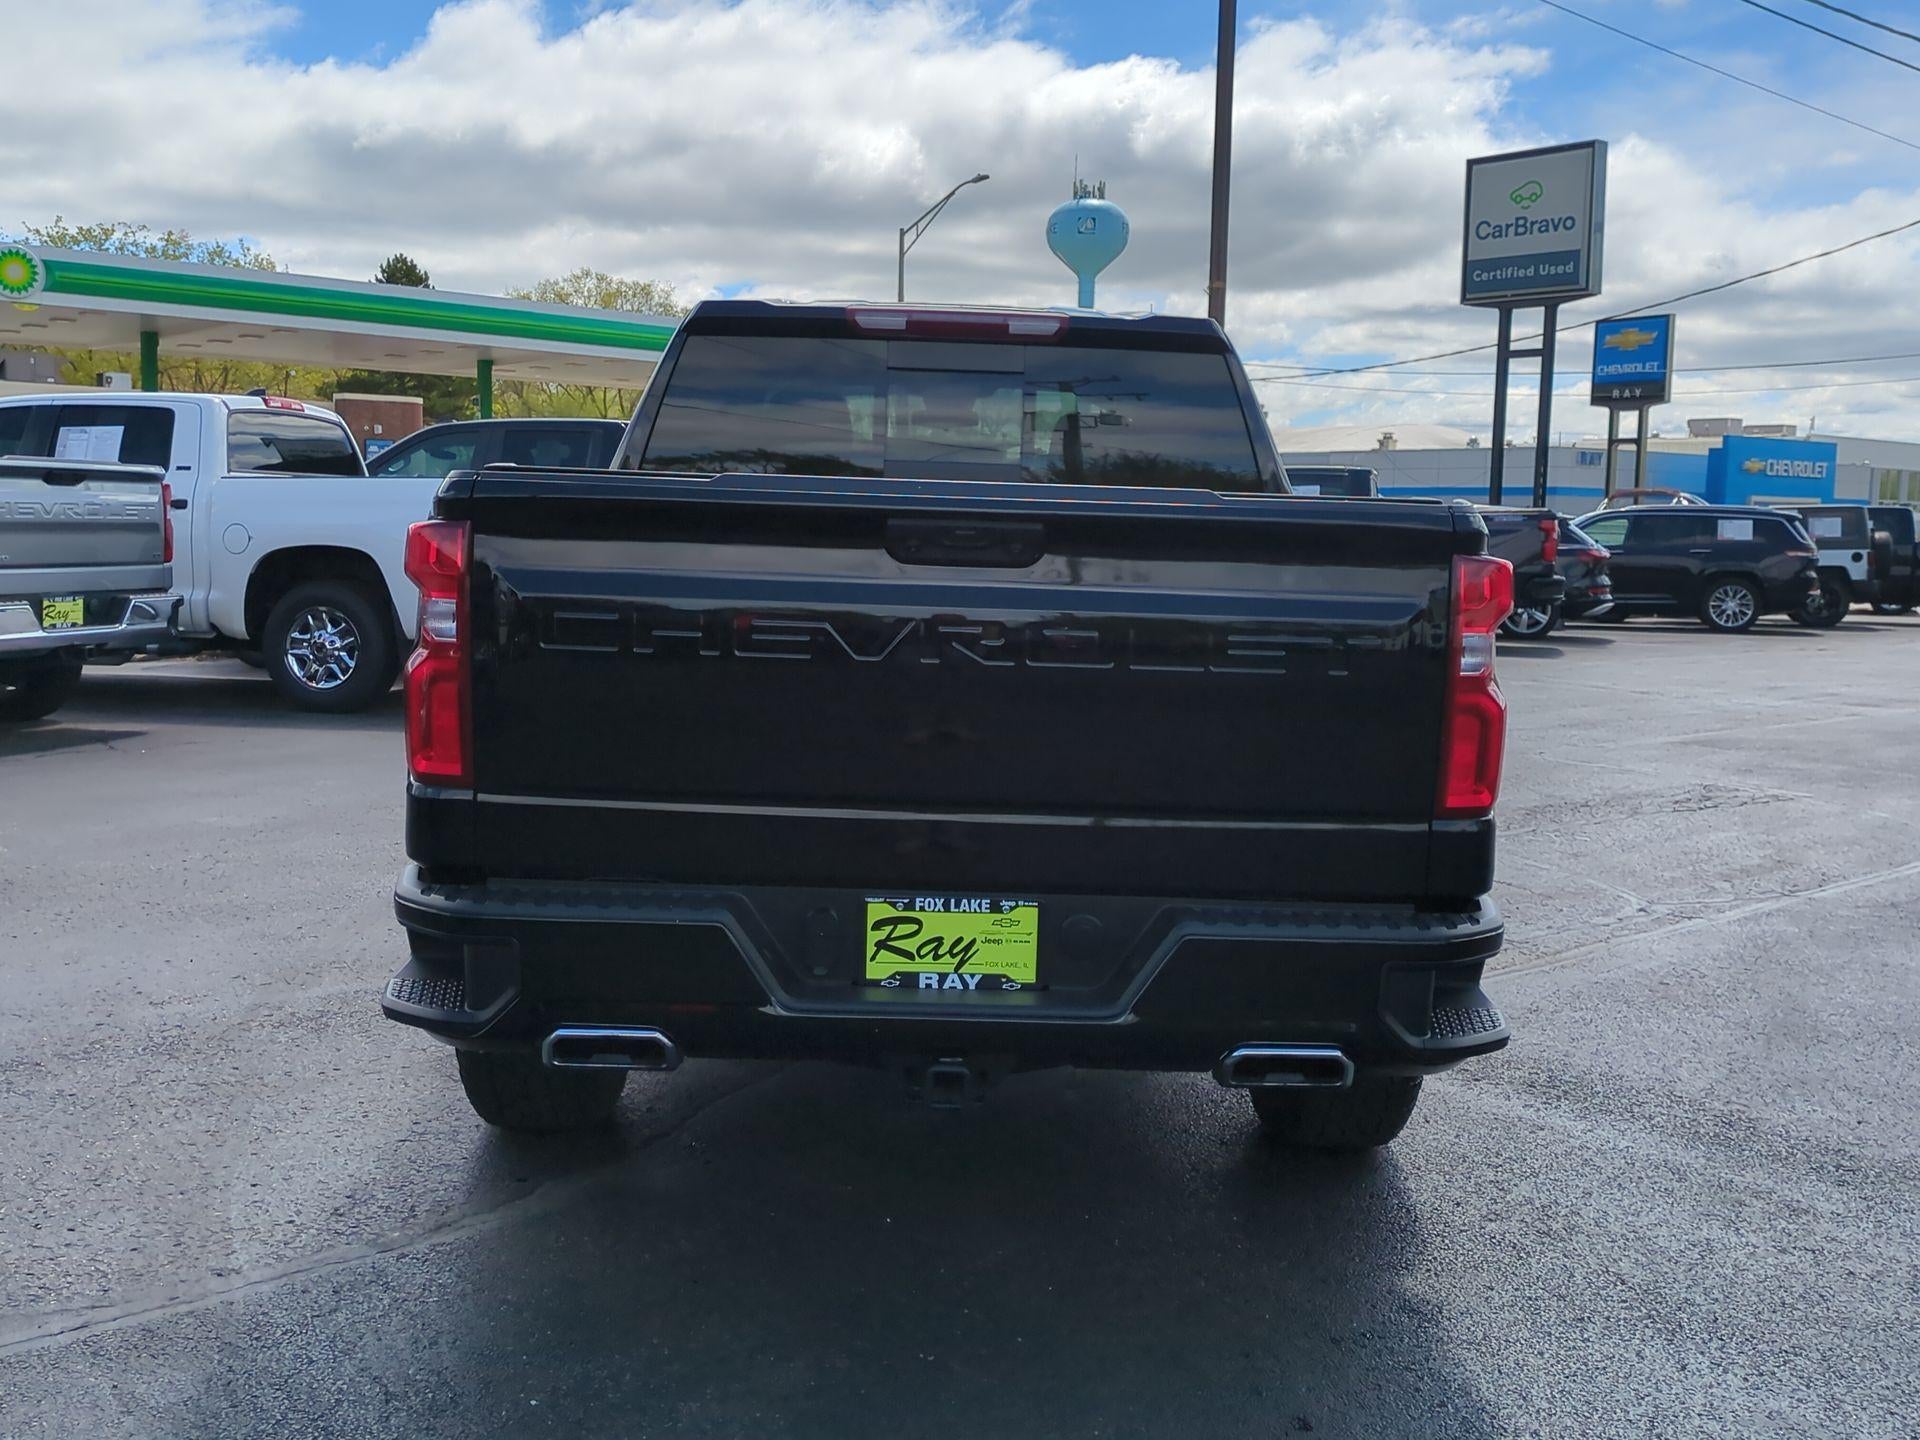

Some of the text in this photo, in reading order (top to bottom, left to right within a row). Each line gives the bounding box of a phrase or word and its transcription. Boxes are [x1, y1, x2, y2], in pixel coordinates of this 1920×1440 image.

[1475, 215, 1576, 240] CarBravo
[1473, 261, 1574, 282] Certified Used
[1597, 361, 1660, 376] CHEVROLET
[1612, 387, 1642, 399] RAY
[1766, 459, 1829, 478] CHEVROLET
[43, 604, 70, 622] Ray
[539, 610, 1382, 676] CHEVROLET
[915, 897, 991, 913] FOX LAKE
[870, 915, 980, 974] Ray
[980, 936, 1004, 946] Jeep
[919, 973, 984, 990] RAY
